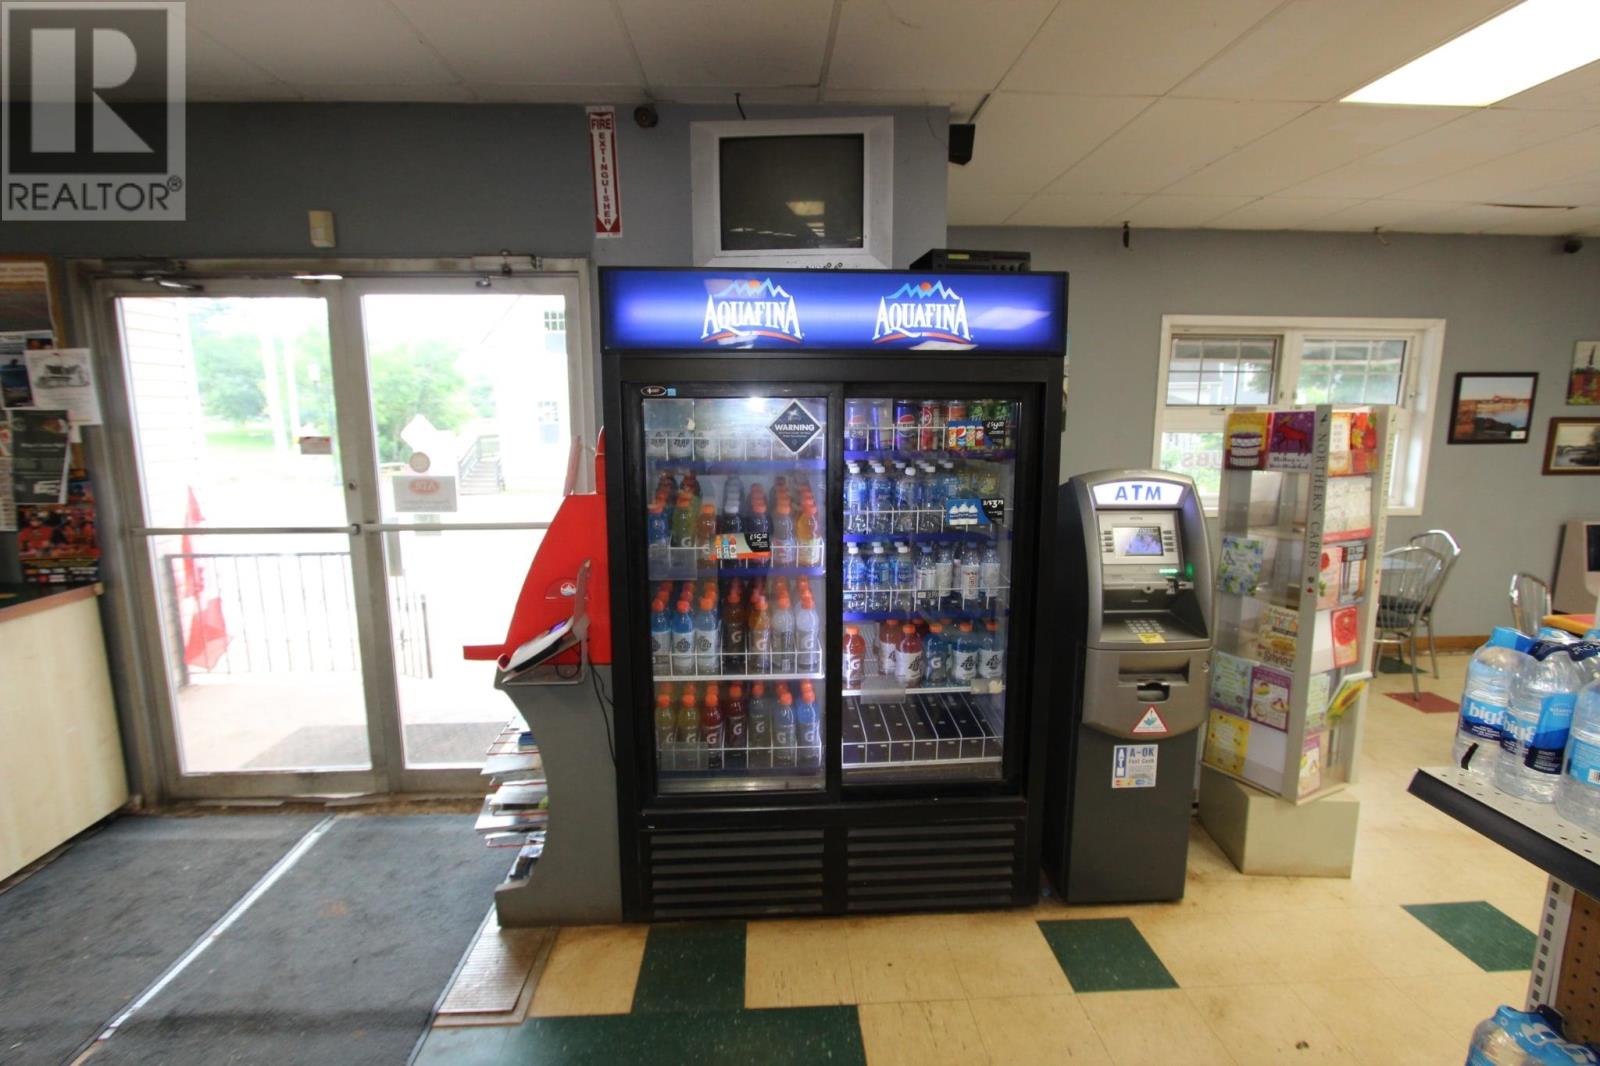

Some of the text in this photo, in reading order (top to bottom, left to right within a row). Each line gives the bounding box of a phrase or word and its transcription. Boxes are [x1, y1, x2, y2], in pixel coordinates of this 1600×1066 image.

[591, 118, 612, 130] FIRE
[598, 131, 612, 226] EXTINGUISHER
[700, 293, 803, 340] AQUAFINA
[872, 295, 972, 341] AQUAFINA
[774, 423, 815, 432] WARNING
[1115, 484, 1162, 501] ATM
[1308, 432, 1328, 568] NORTHERN CARDS
[931, 656, 942, 669] G
